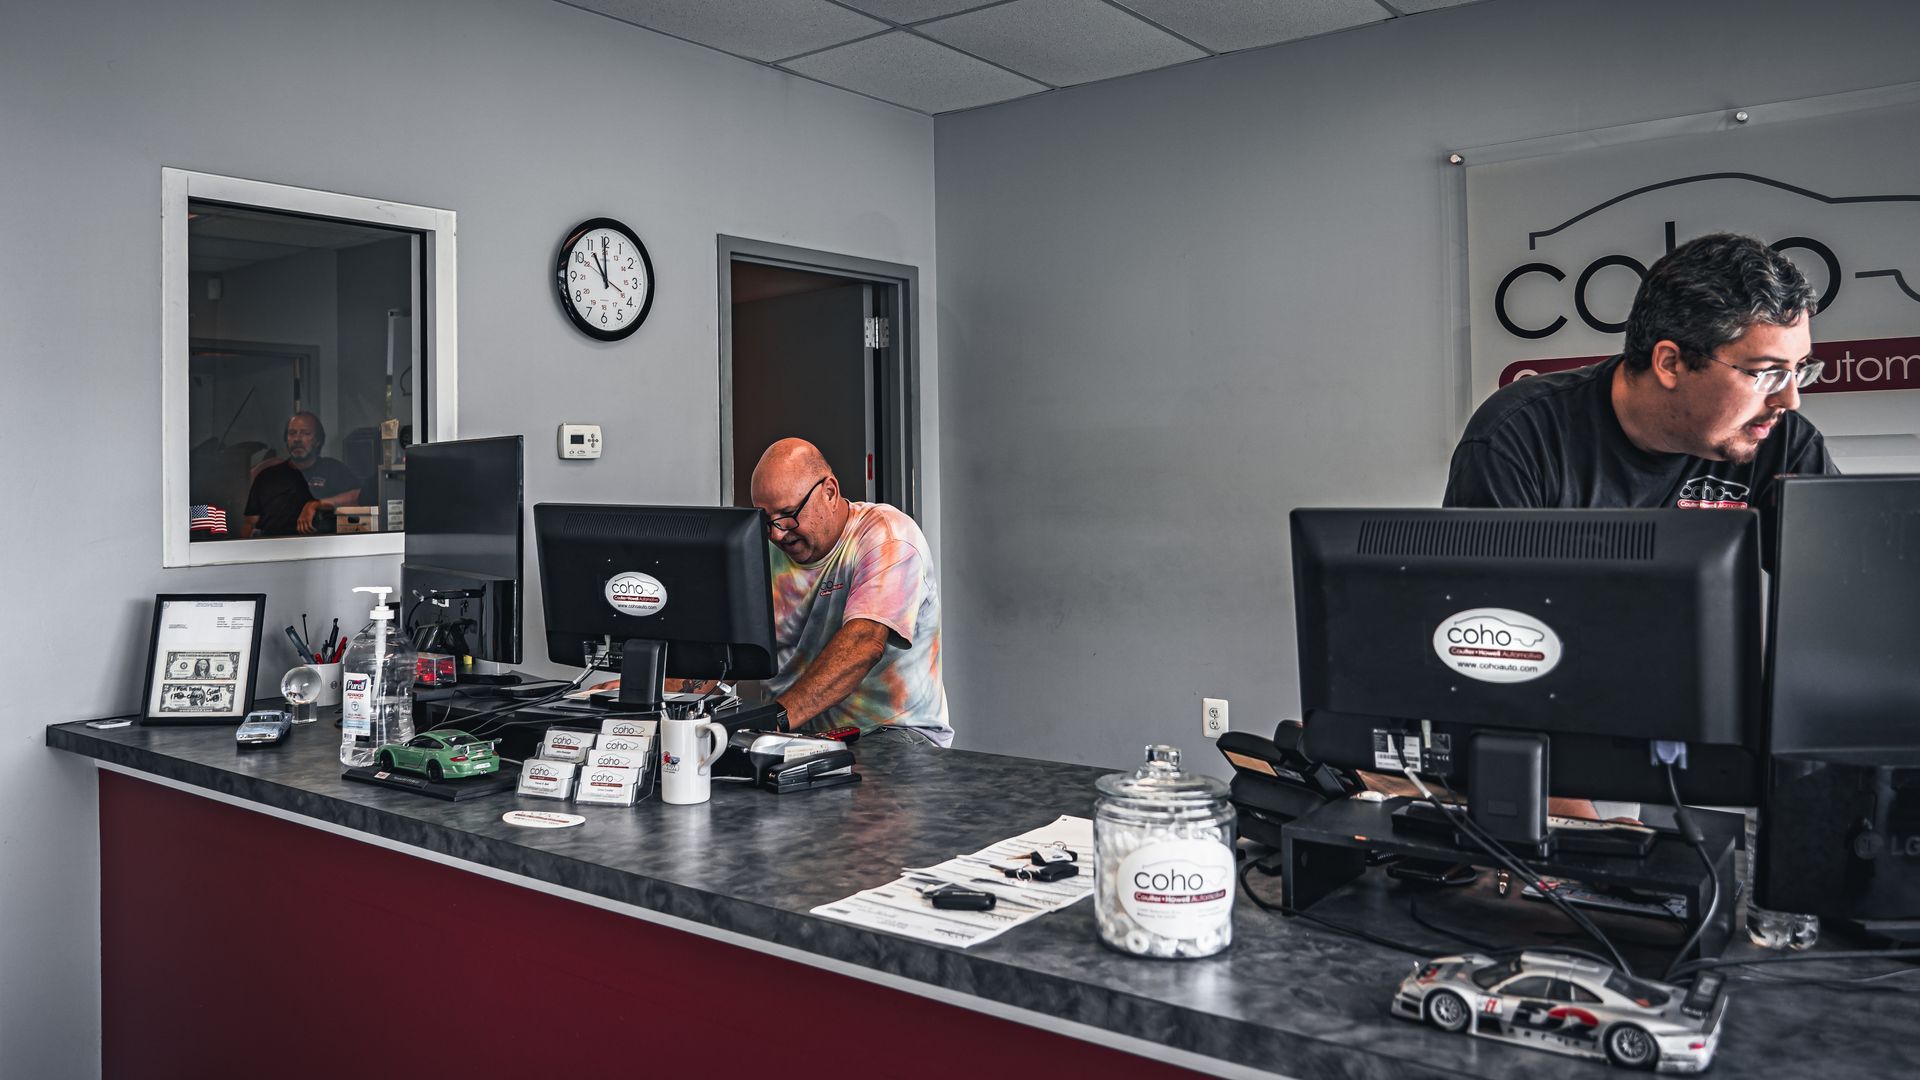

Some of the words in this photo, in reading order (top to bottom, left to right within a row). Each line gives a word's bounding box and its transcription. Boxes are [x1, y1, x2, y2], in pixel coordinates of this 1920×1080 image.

[587, 239, 594, 251] 11
[601, 236, 610, 248] 12
[575, 251, 584, 264] 10
[627, 258, 634, 269] 2
[570, 270, 577, 282] 9
[1494, 221, 1842, 339] coo
[632, 278, 638, 290] 3
[576, 290, 582, 302] 8
[626, 296, 633, 308] 4
[586, 306, 592, 319] 7
[600, 312, 608, 324] 6
[616, 309, 622, 320] 5
[1815, 351, 1920, 383] utom
[612, 581, 644, 594] coho
[1448, 624, 1512, 646] coho
[1457, 662, 1538, 673] www.cohoauto.com
[612, 726, 634, 734] coho
[553, 736, 572, 745] coho
[606, 742, 628, 750] coho
[598, 756, 620, 766] coho
[530, 766, 550, 776] coho
[591, 774, 614, 782] coho
[1134, 868, 1203, 890] coho
